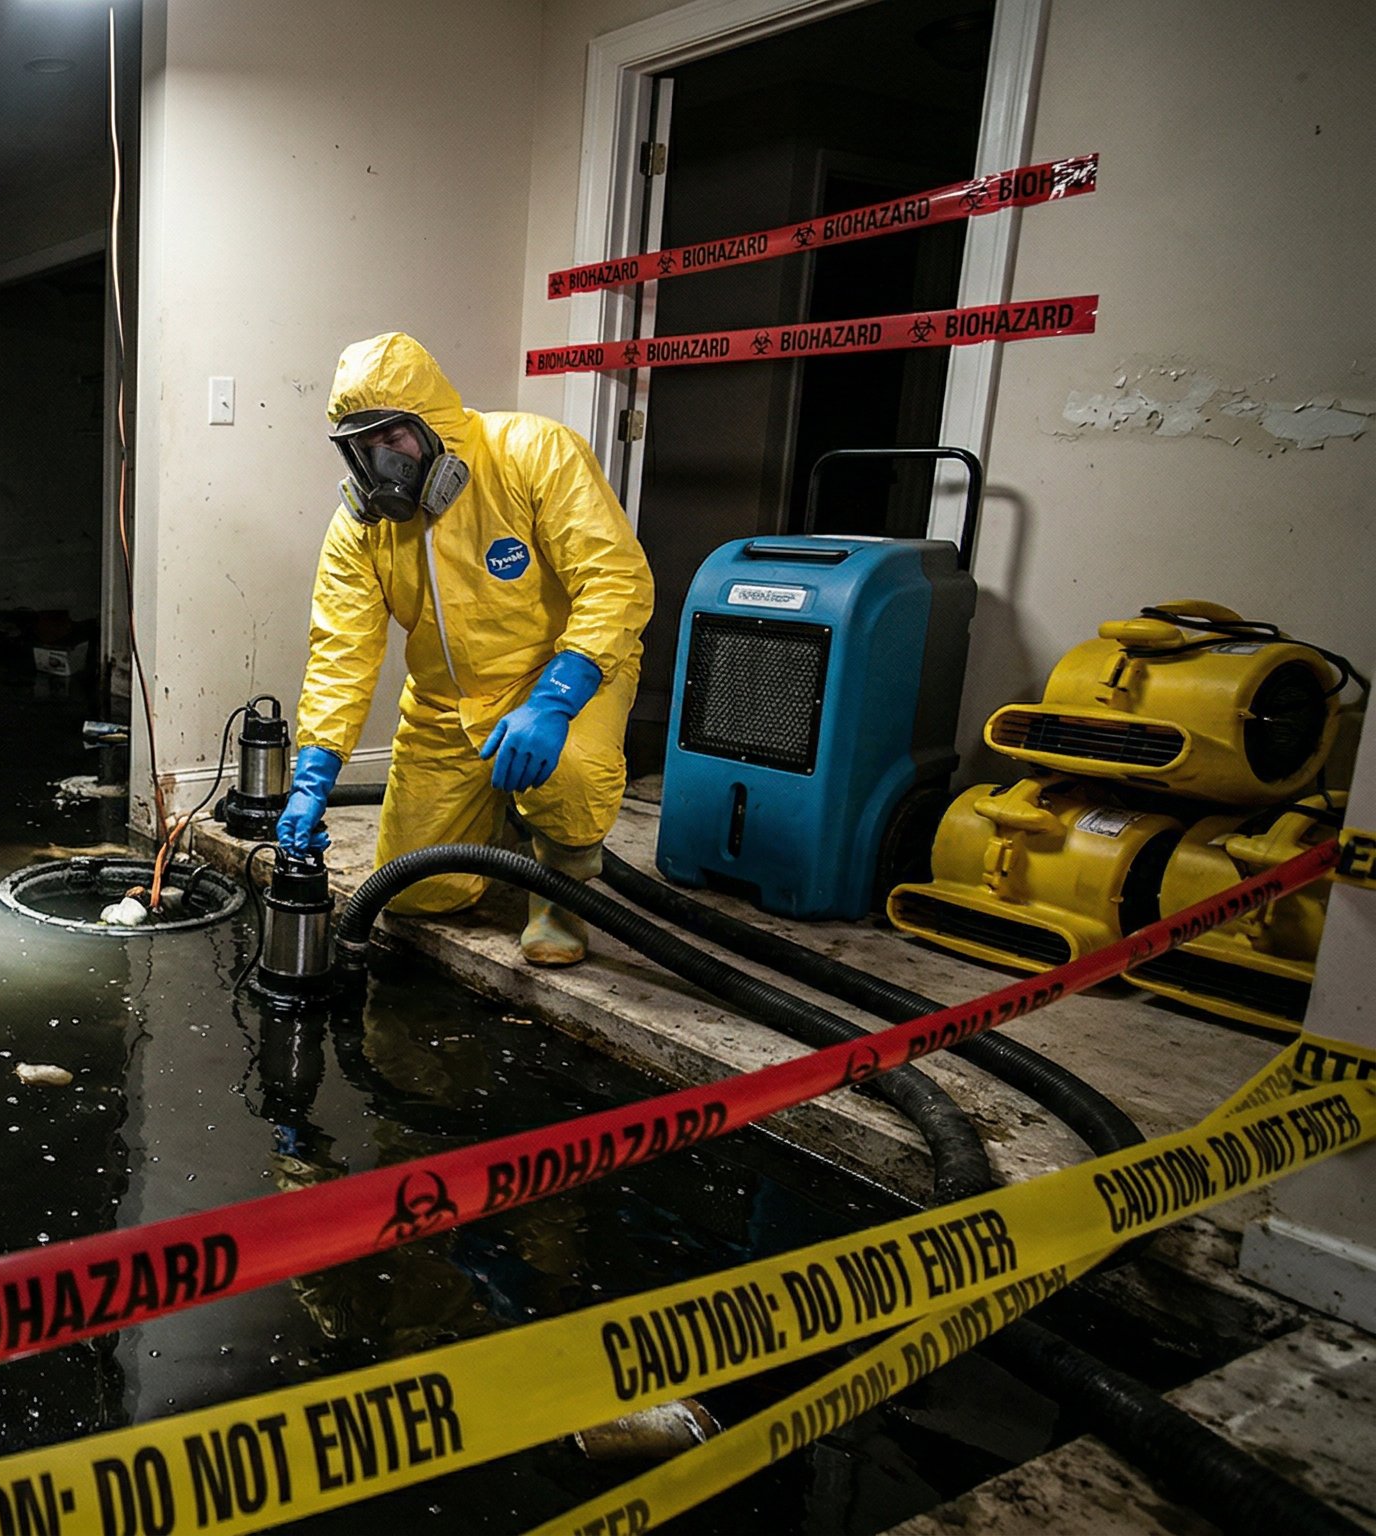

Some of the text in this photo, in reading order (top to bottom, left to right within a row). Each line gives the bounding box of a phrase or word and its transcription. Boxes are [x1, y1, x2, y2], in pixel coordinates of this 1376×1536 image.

[682, 234, 768, 268] BIOHAZARD
[823, 198, 930, 240] BIOHAZARD
[646, 337, 730, 362] BIOHAZARD
[780, 323, 882, 351] BIOHAZARD
[945, 303, 1074, 339] BIOHAZARD
[481, 1101, 728, 1215] BIOHAZARD
[93, 1446, 176, 1536] DO
[183, 1412, 294, 1529] NOT
[304, 1372, 464, 1493] ENTER
[601, 1281, 787, 1401] CAUTION:
[781, 1262, 843, 1342] DO
[836, 1239, 914, 1325] NOT
[908, 1208, 1018, 1299] ENTER
[1093, 1144, 1218, 1234] CAUTION:
[1206, 1131, 1252, 1192] DO
[1241, 1114, 1296, 1179] NOT
[1286, 1093, 1362, 1160] ENTER
[903, 1331, 942, 1381] DO
[939, 1297, 998, 1356] NOT
